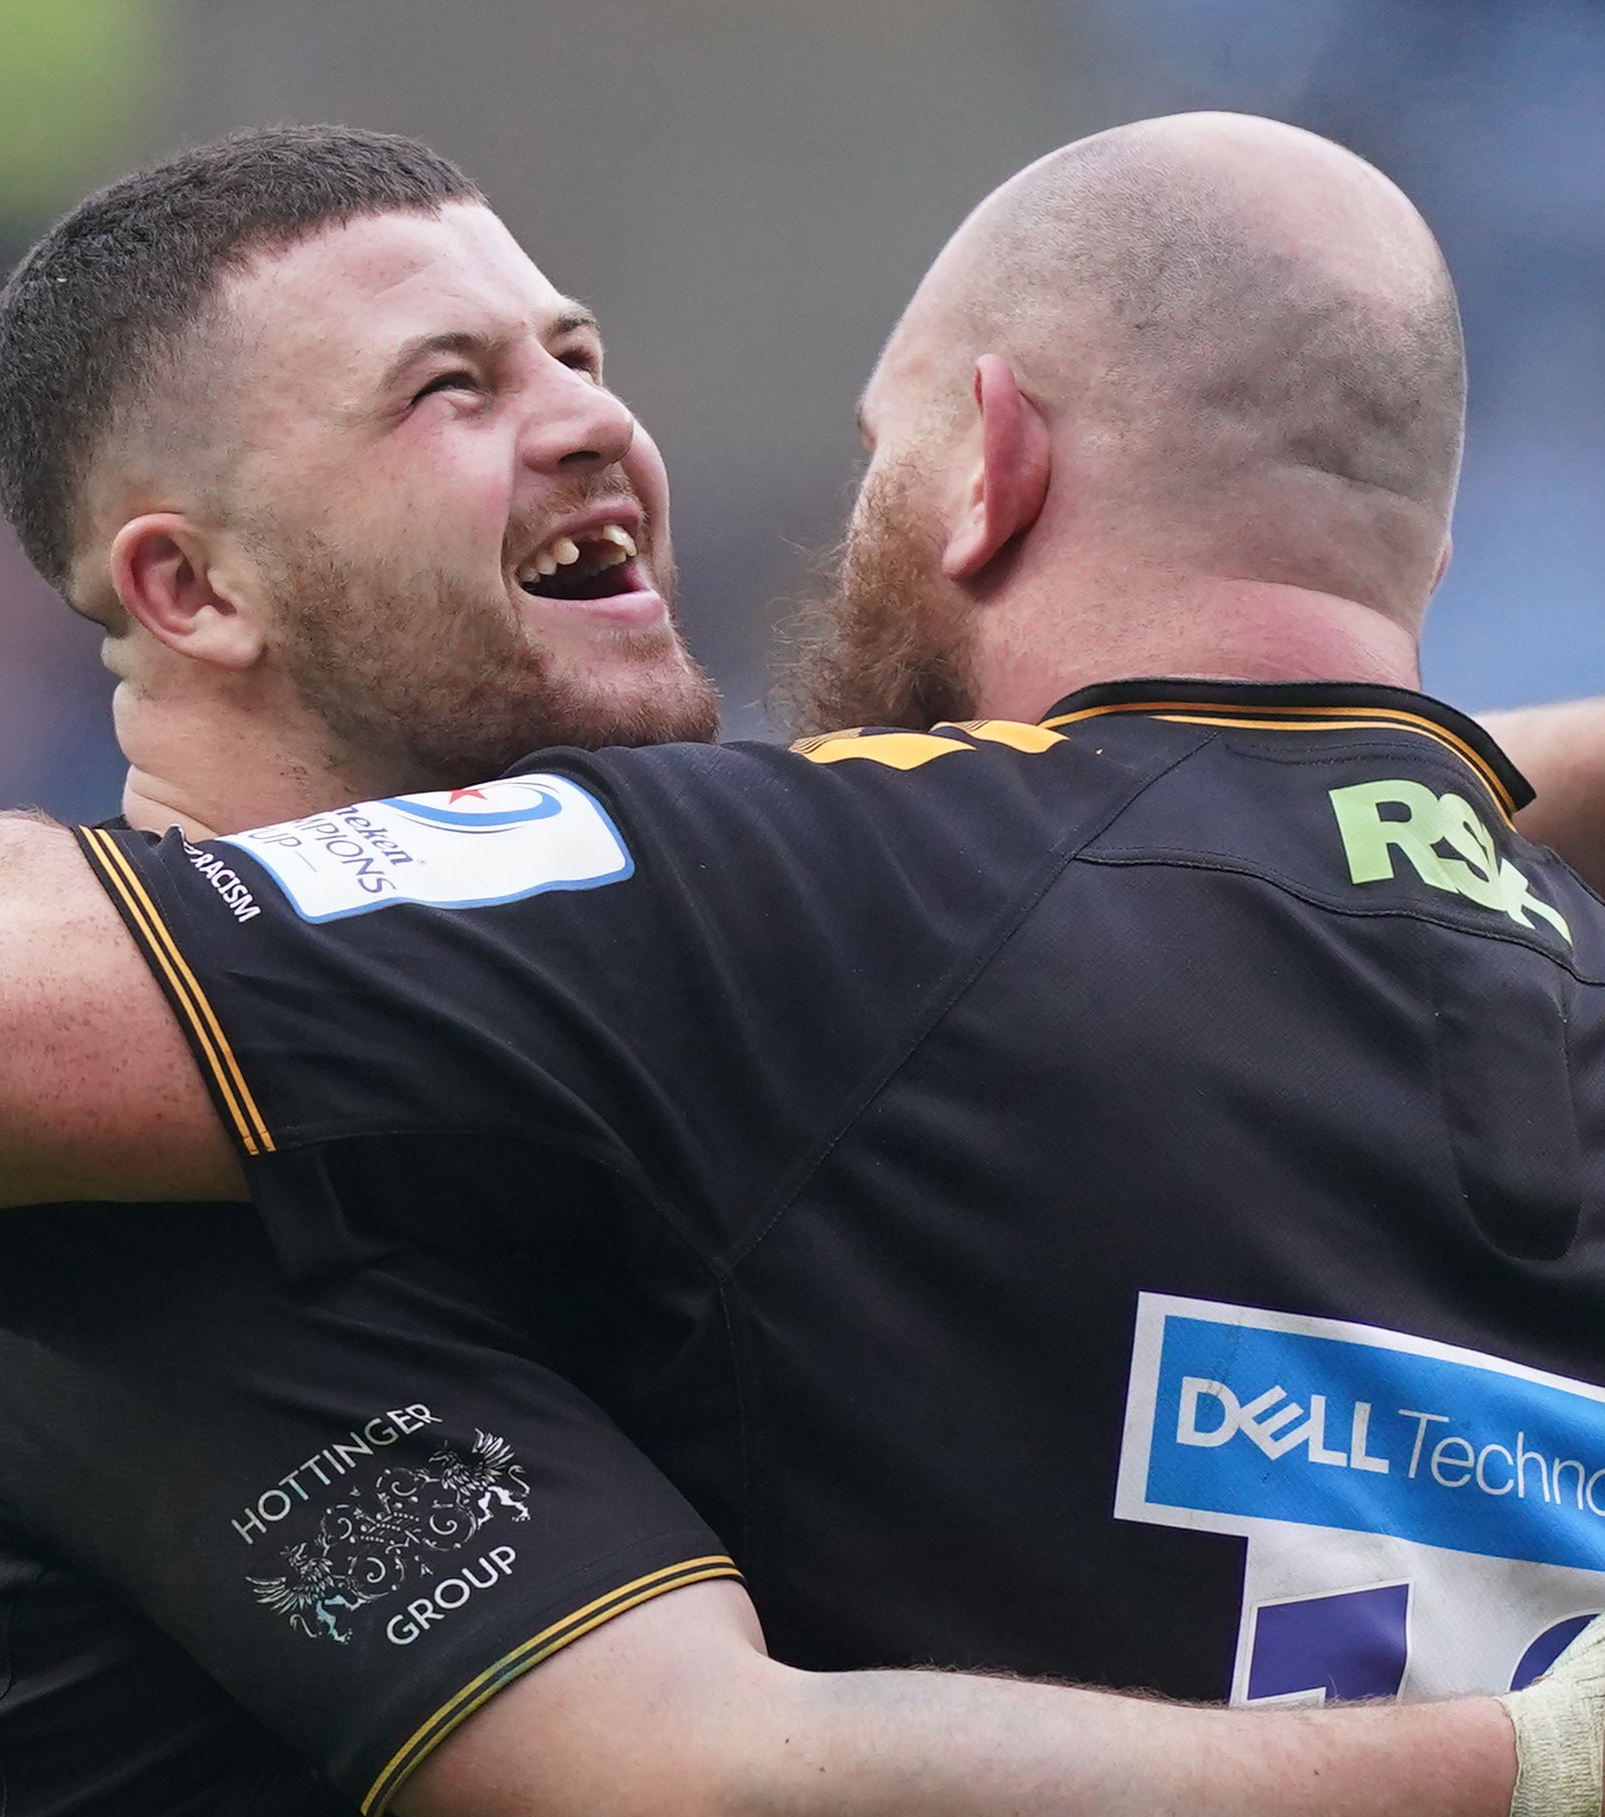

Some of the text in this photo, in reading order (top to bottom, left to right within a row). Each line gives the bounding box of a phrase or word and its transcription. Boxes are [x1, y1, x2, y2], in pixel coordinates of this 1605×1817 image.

[336, 805, 414, 866] neken
[190, 852, 262, 923] RACISM
[231, 1403, 443, 1545] HOTTINGER
[1176, 1376, 1390, 1474] DELL
[385, 1546, 517, 1646] GROUP
